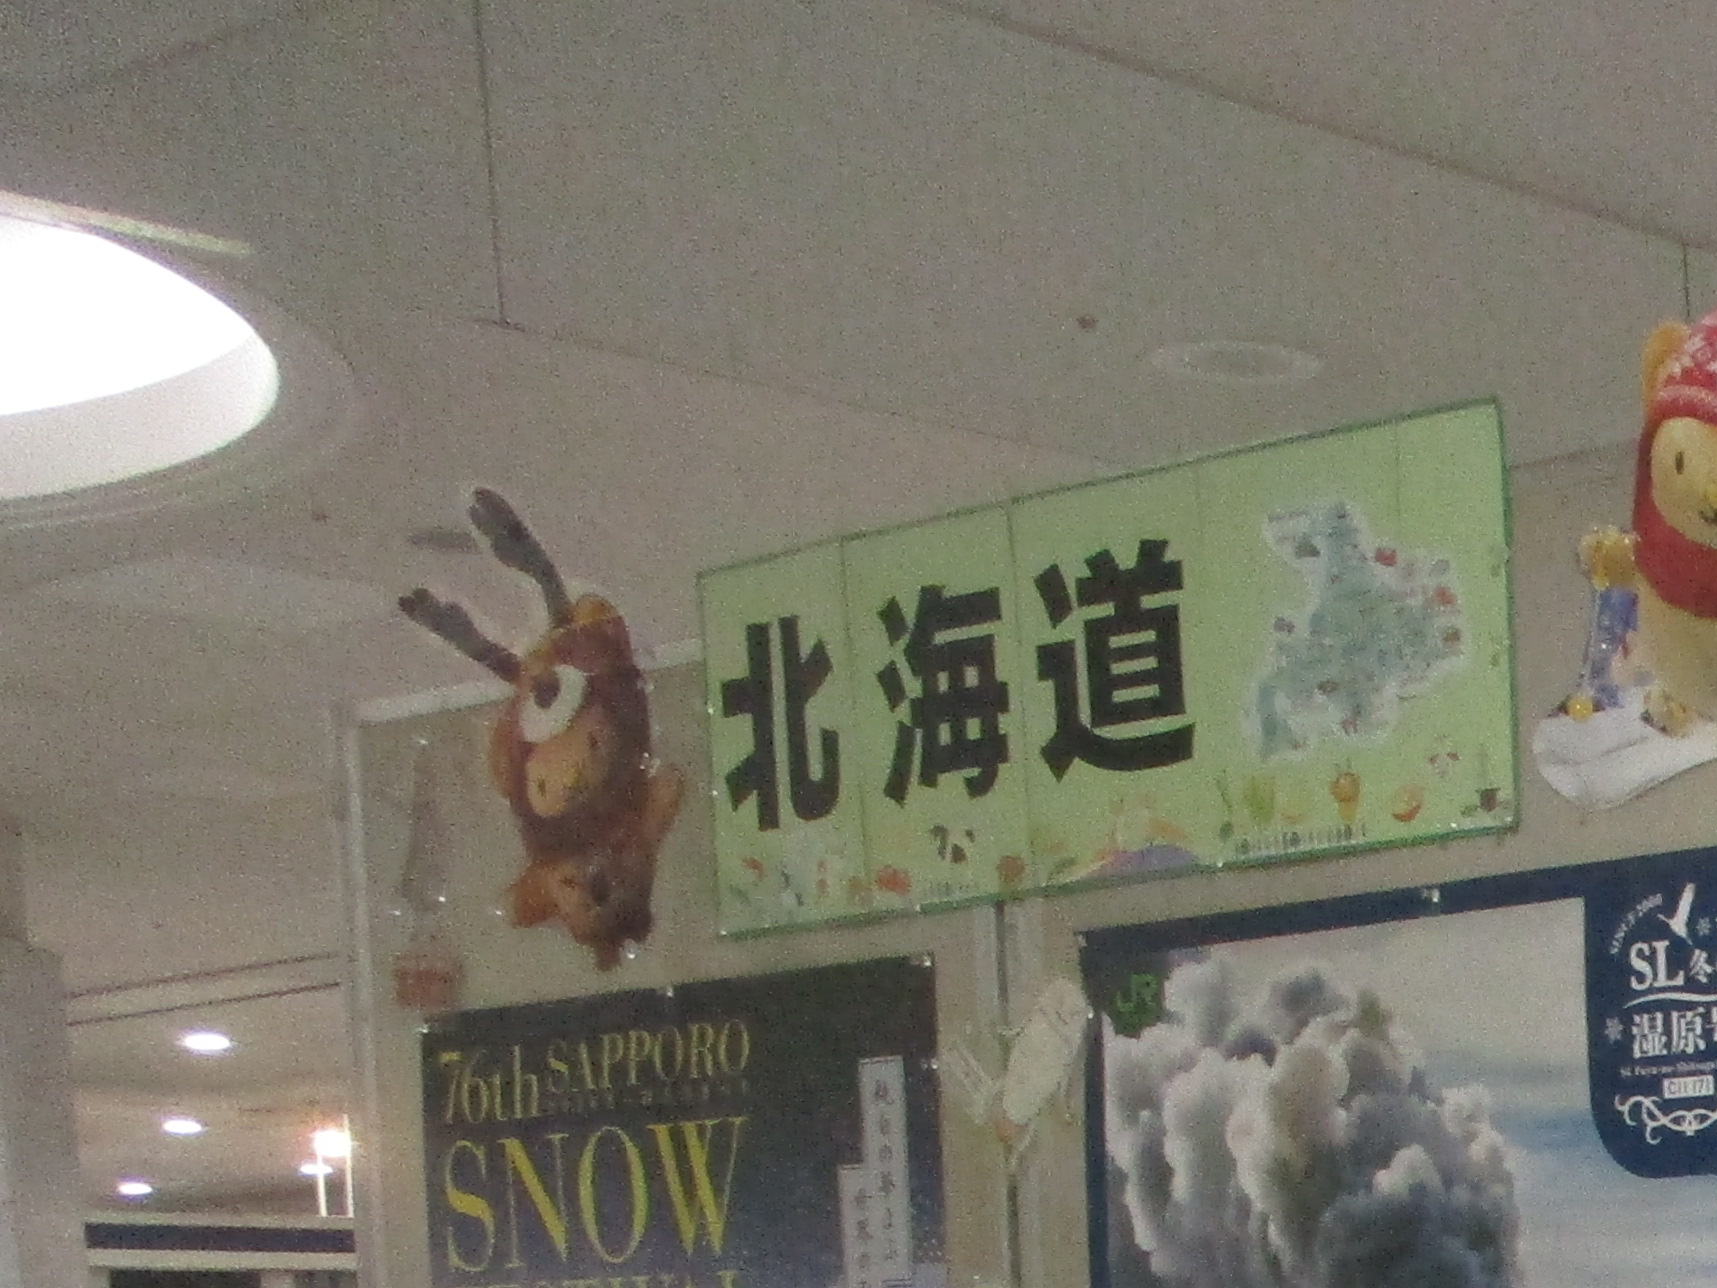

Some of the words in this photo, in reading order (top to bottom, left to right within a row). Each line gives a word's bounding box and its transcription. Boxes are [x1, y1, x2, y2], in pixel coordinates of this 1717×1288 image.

[721, 537, 1197, 832] 北海道
[438, 1042, 541, 1125] 76th
[545, 1018, 751, 1097] SAPPORO
[441, 1114, 750, 1275] SNOW
